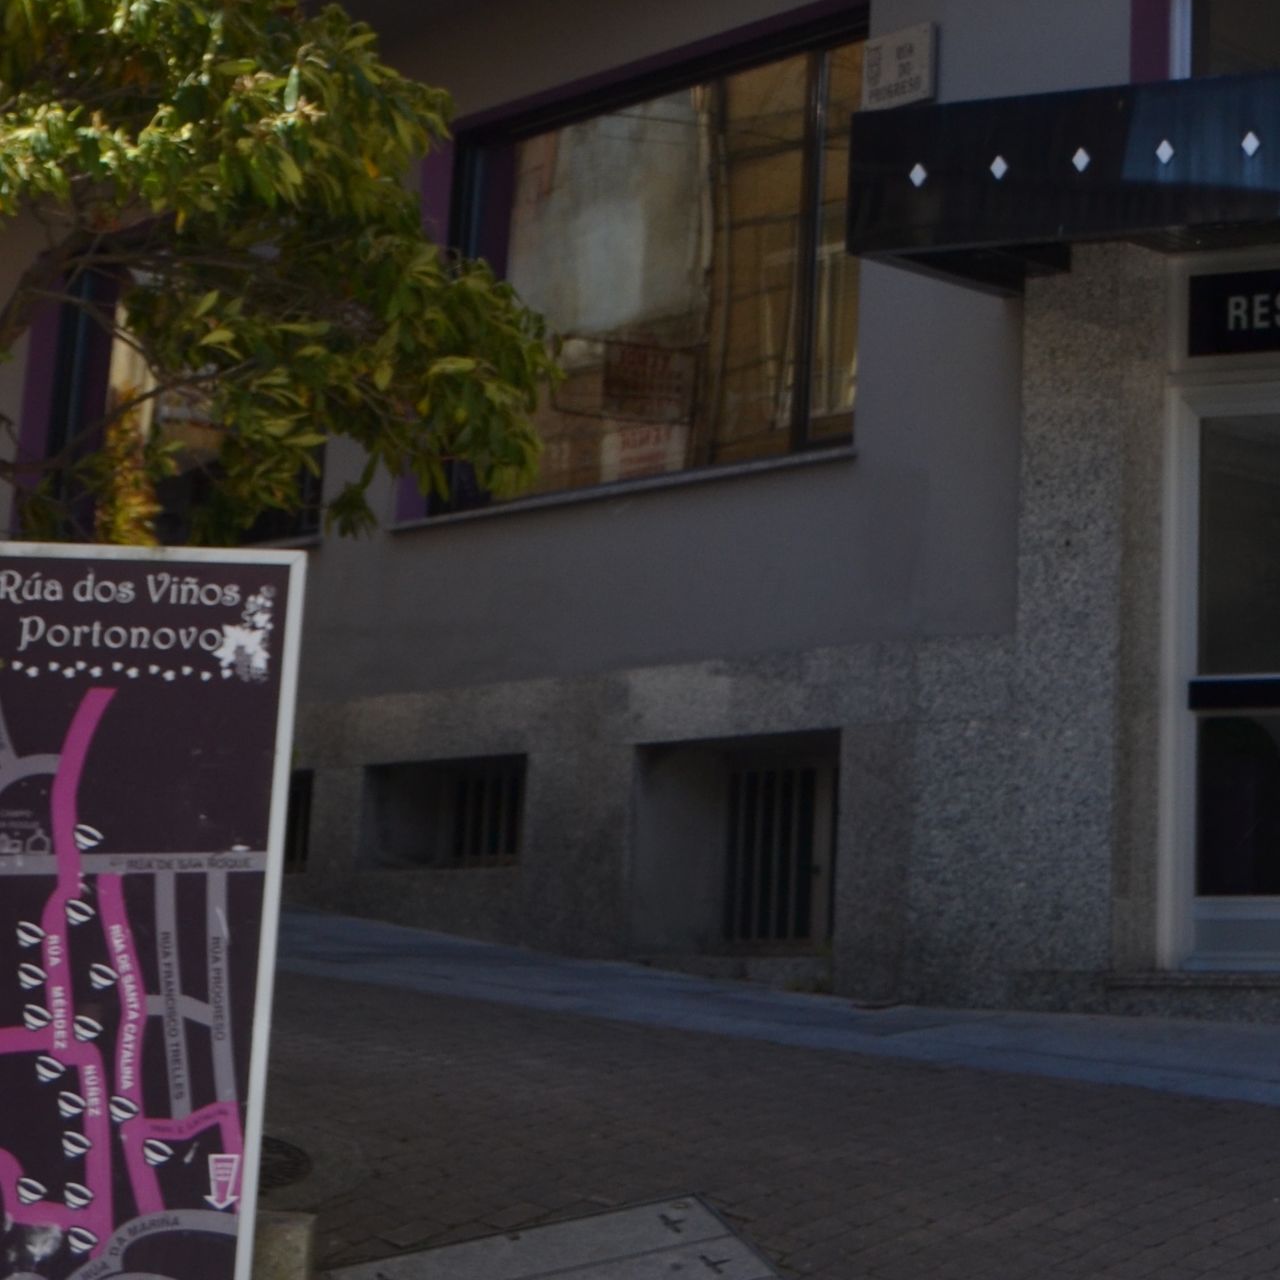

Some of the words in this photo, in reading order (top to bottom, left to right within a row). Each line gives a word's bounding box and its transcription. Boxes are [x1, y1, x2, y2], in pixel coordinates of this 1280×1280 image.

[868, 76, 922, 103] PROGRESO
[0, 569, 63, 604] Rúa
[73, 567, 136, 603] dos
[147, 572, 241, 606] Viños
[18, 615, 223, 651] Portonovo
[47, 933, 63, 966] RÚA
[116, 953, 131, 973] DE
[51, 986, 68, 1049] MÉNDEZ
[121, 974, 140, 1020] SANTA
[212, 967, 225, 1041] PROGRESO
[163, 962, 179, 1038] FRANCISCO
[171, 1042, 185, 1100] TRELLES
[121, 1023, 137, 1090] CATALINA
[84, 1065, 102, 1116] NÚÑEZ
